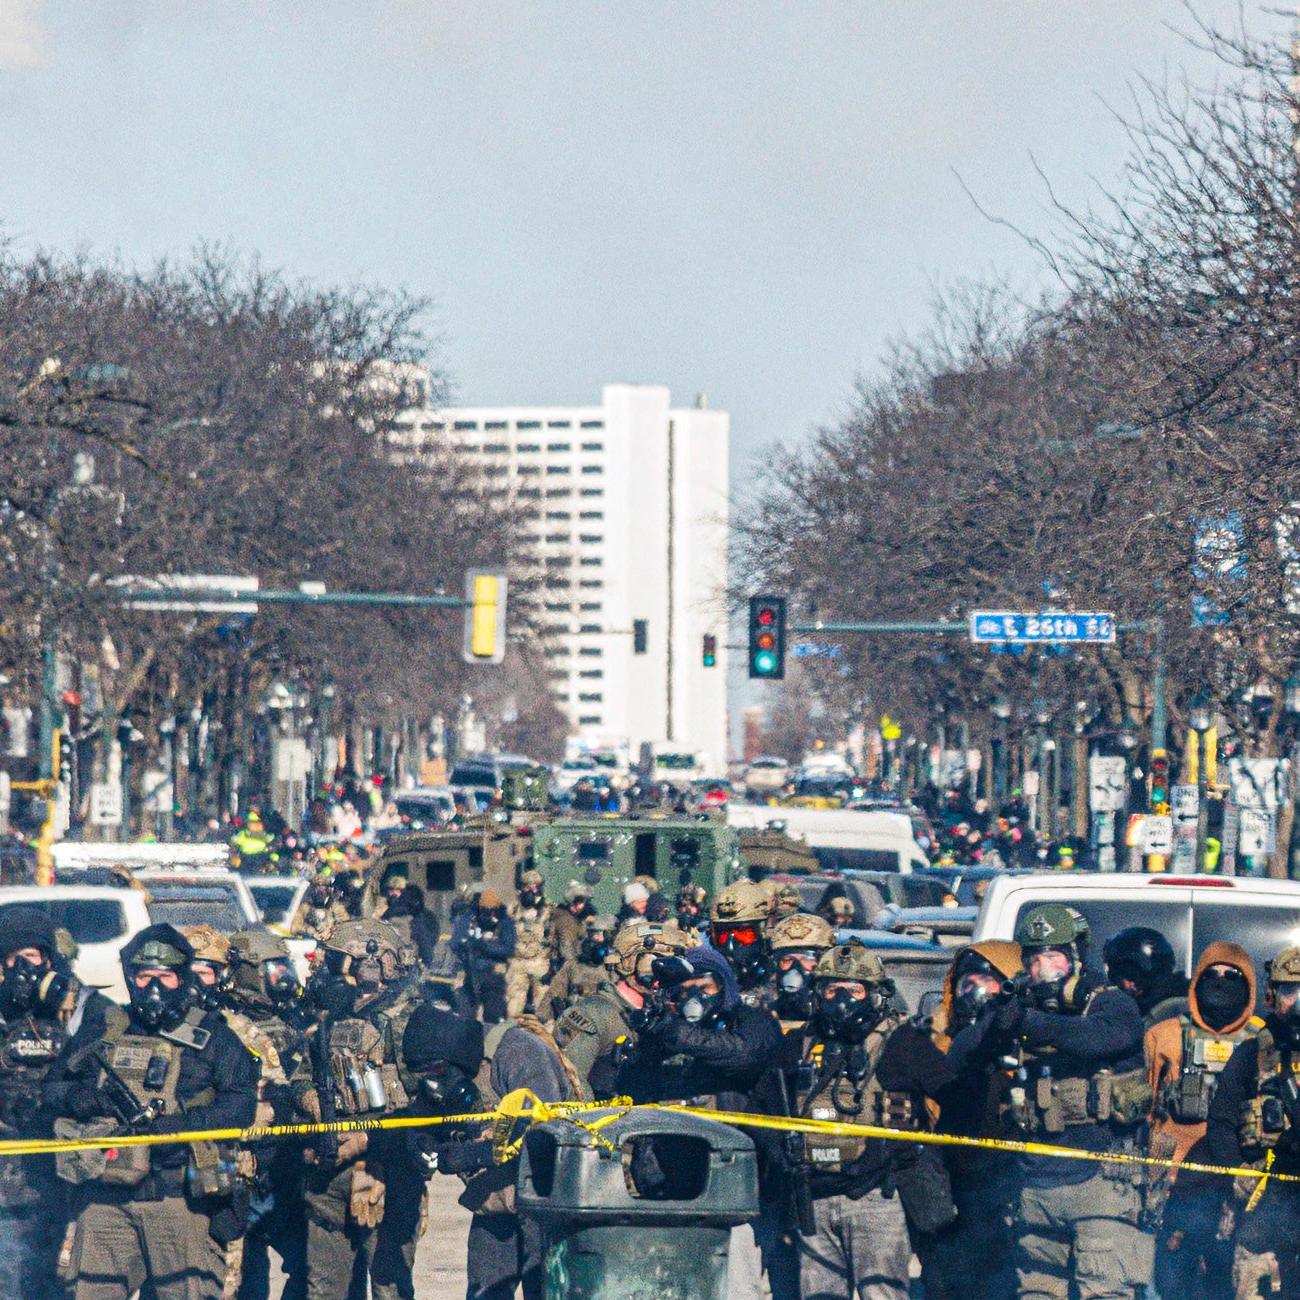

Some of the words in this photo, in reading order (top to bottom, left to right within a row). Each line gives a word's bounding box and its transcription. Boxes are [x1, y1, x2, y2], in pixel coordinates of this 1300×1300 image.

[1003, 617, 1019, 636] E
[1025, 618, 1078, 636] 26th
[1086, 618, 1110, 636] St
[17, 1040, 52, 1049] POLICE
[812, 1148, 840, 1162] POLICE
